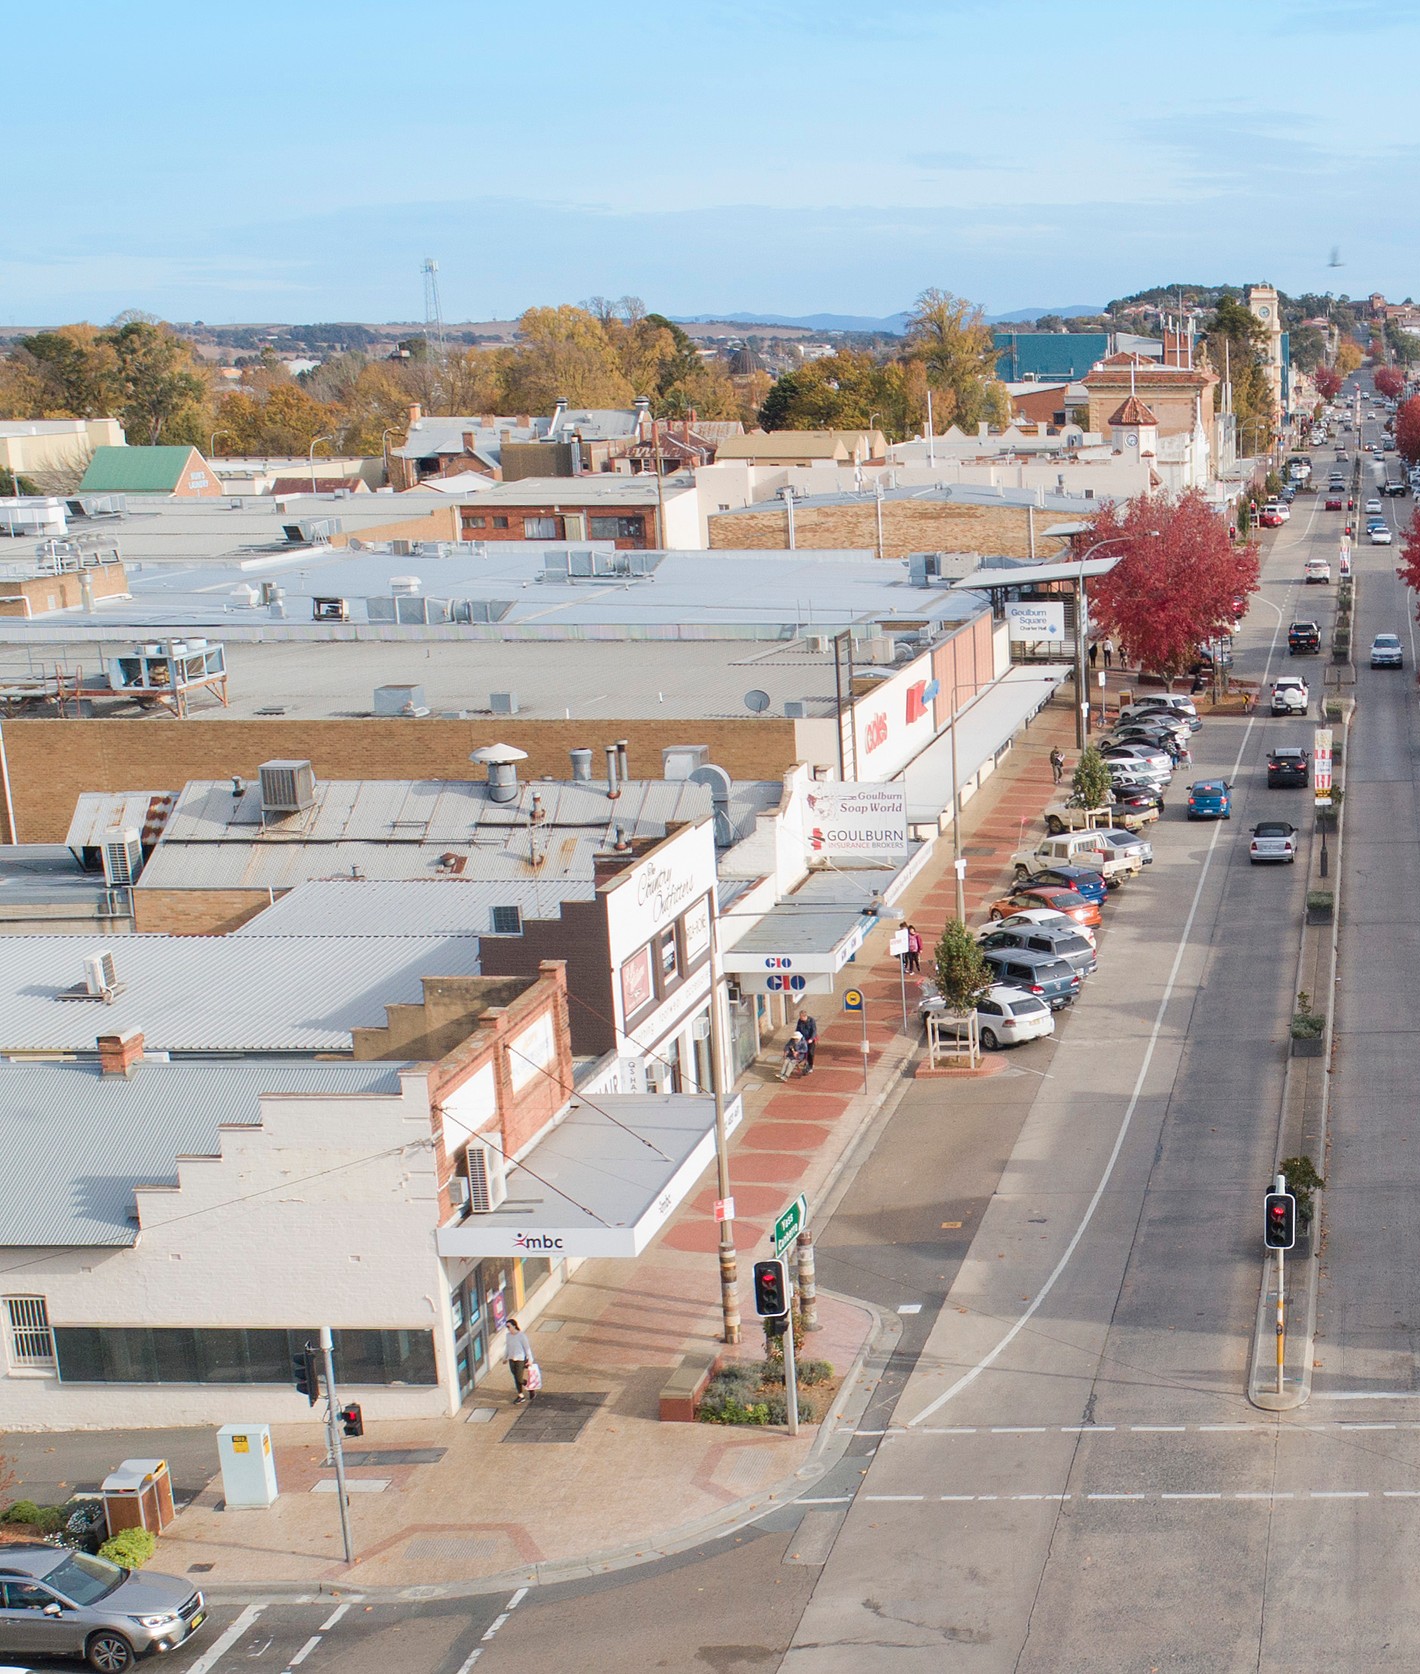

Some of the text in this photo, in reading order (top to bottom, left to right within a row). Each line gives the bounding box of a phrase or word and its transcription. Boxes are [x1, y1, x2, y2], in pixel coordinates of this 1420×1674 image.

[1011, 608, 1047, 617] Goulburn
[1019, 616, 1047, 625] Square
[857, 791, 903, 800] Goulburn
[839, 802, 903, 815] Soap World
[827, 830, 904, 841] GOULBURN
[637, 868, 673, 907] Country
[765, 957, 792, 969] GIO
[766, 975, 806, 991] GIO
[781, 1213, 794, 1231] Yass
[526, 1234, 563, 1249] mbc
[778, 1222, 798, 1251] Canberra
